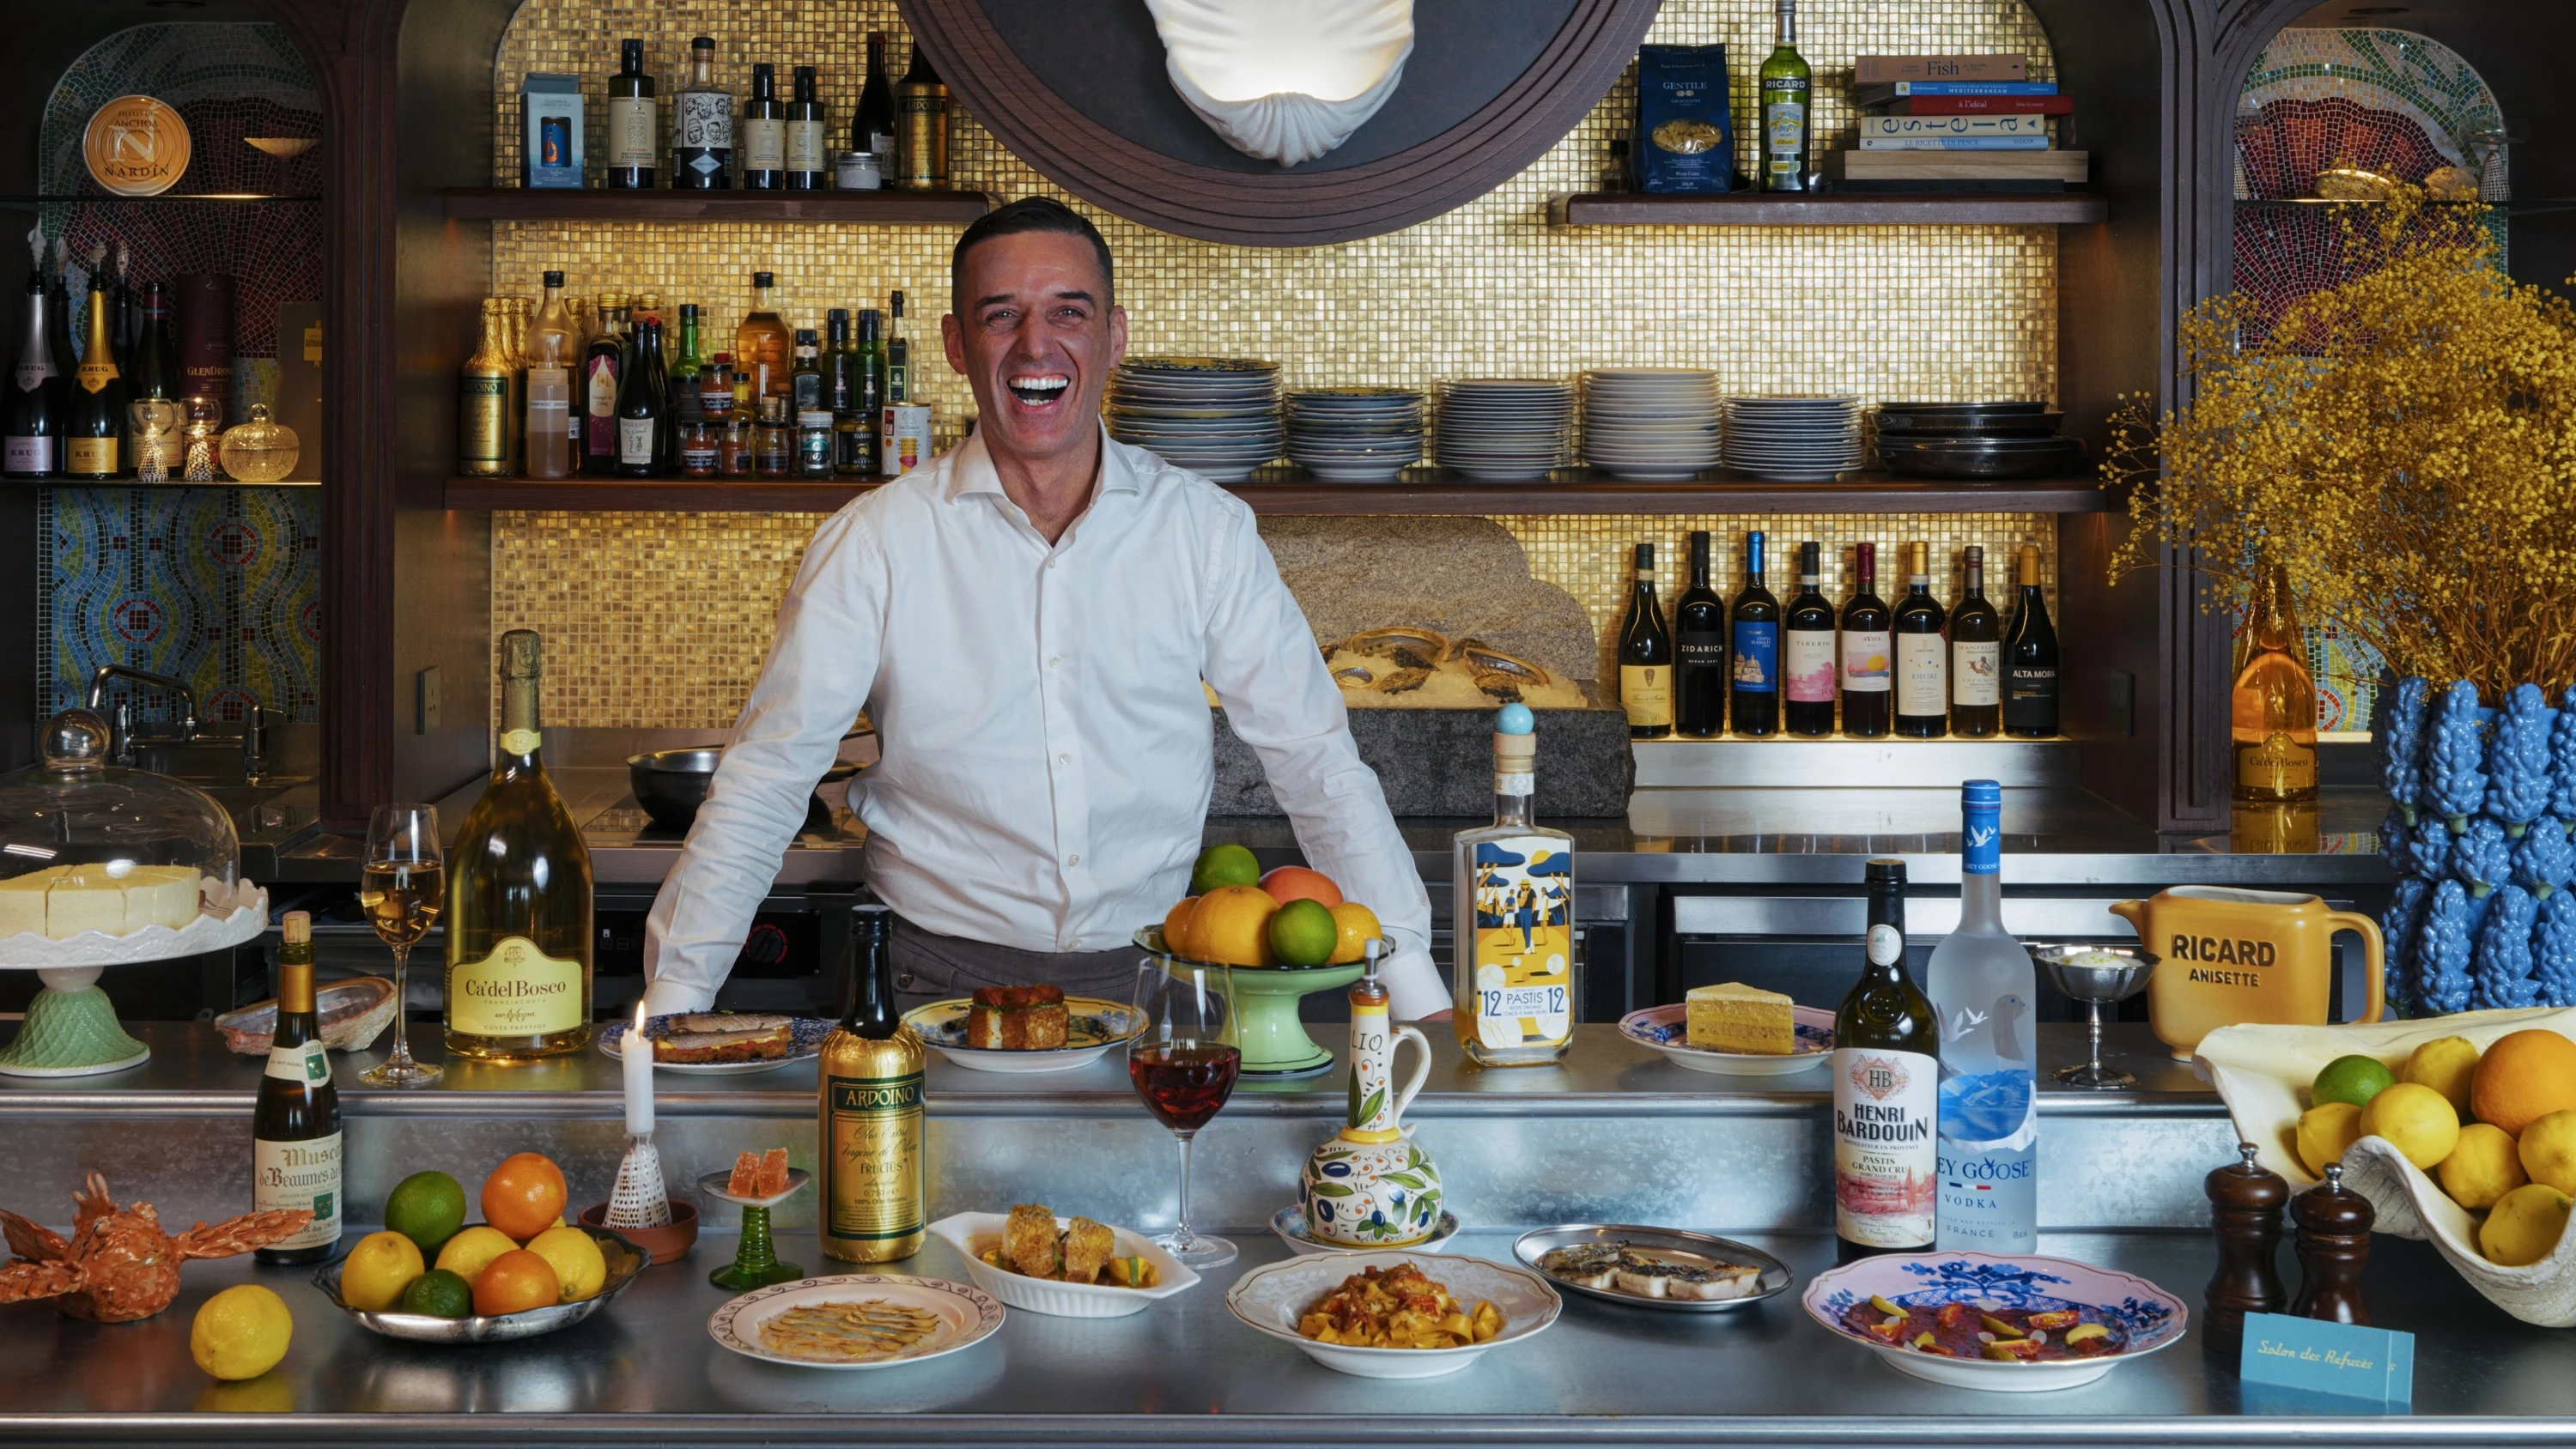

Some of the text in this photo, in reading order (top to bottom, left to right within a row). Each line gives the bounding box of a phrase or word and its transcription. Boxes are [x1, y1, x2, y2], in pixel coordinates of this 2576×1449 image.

[1927, 61, 1959, 76] Fish
[1662, 82, 1708, 90] GENTILE
[1765, 79, 1806, 88] RICARD
[906, 101, 942, 110] ARDOINO
[114, 118, 158, 127] ANCHOA
[187, 366, 234, 376] GLENDRON
[2013, 670, 2057, 678] ALTA MORA
[2281, 757, 2308, 767] Bosco
[1978, 862, 1997, 870] GOOSE
[2172, 933, 2276, 967] RICARD
[2189, 967, 2260, 987] ANISETTE
[515, 980, 566, 997] Bosco
[1483, 990, 1502, 1017] 12
[1507, 991, 1543, 1005] PASTIS
[1546, 986, 1565, 1014] 12
[1868, 1070, 1893, 1088] HB
[845, 1086, 914, 1108] ARDOINO
[1854, 1102, 1905, 1123] HENRI
[854, 1123, 908, 1140] Olio Extra
[1837, 1109, 1928, 1142] BARDOUIN
[281, 1144, 341, 1167] Musca
[841, 1137, 917, 1164] Vergine di Oliva
[860, 1161, 902, 1174] FRUCTUS
[1852, 1162, 1886, 1173] GRAND
[1862, 1155, 1896, 1165] PASTIS
[1937, 1156, 2030, 1180] EY GOOSE
[259, 1170, 270, 1186] de
[267, 1167, 329, 1187] Beaumes
[1944, 1193, 1997, 1209] VODKA
[1946, 1225, 1996, 1238] FRANCE
[2257, 1340, 2295, 1359] Salon
[2300, 1347, 2321, 1361] des
